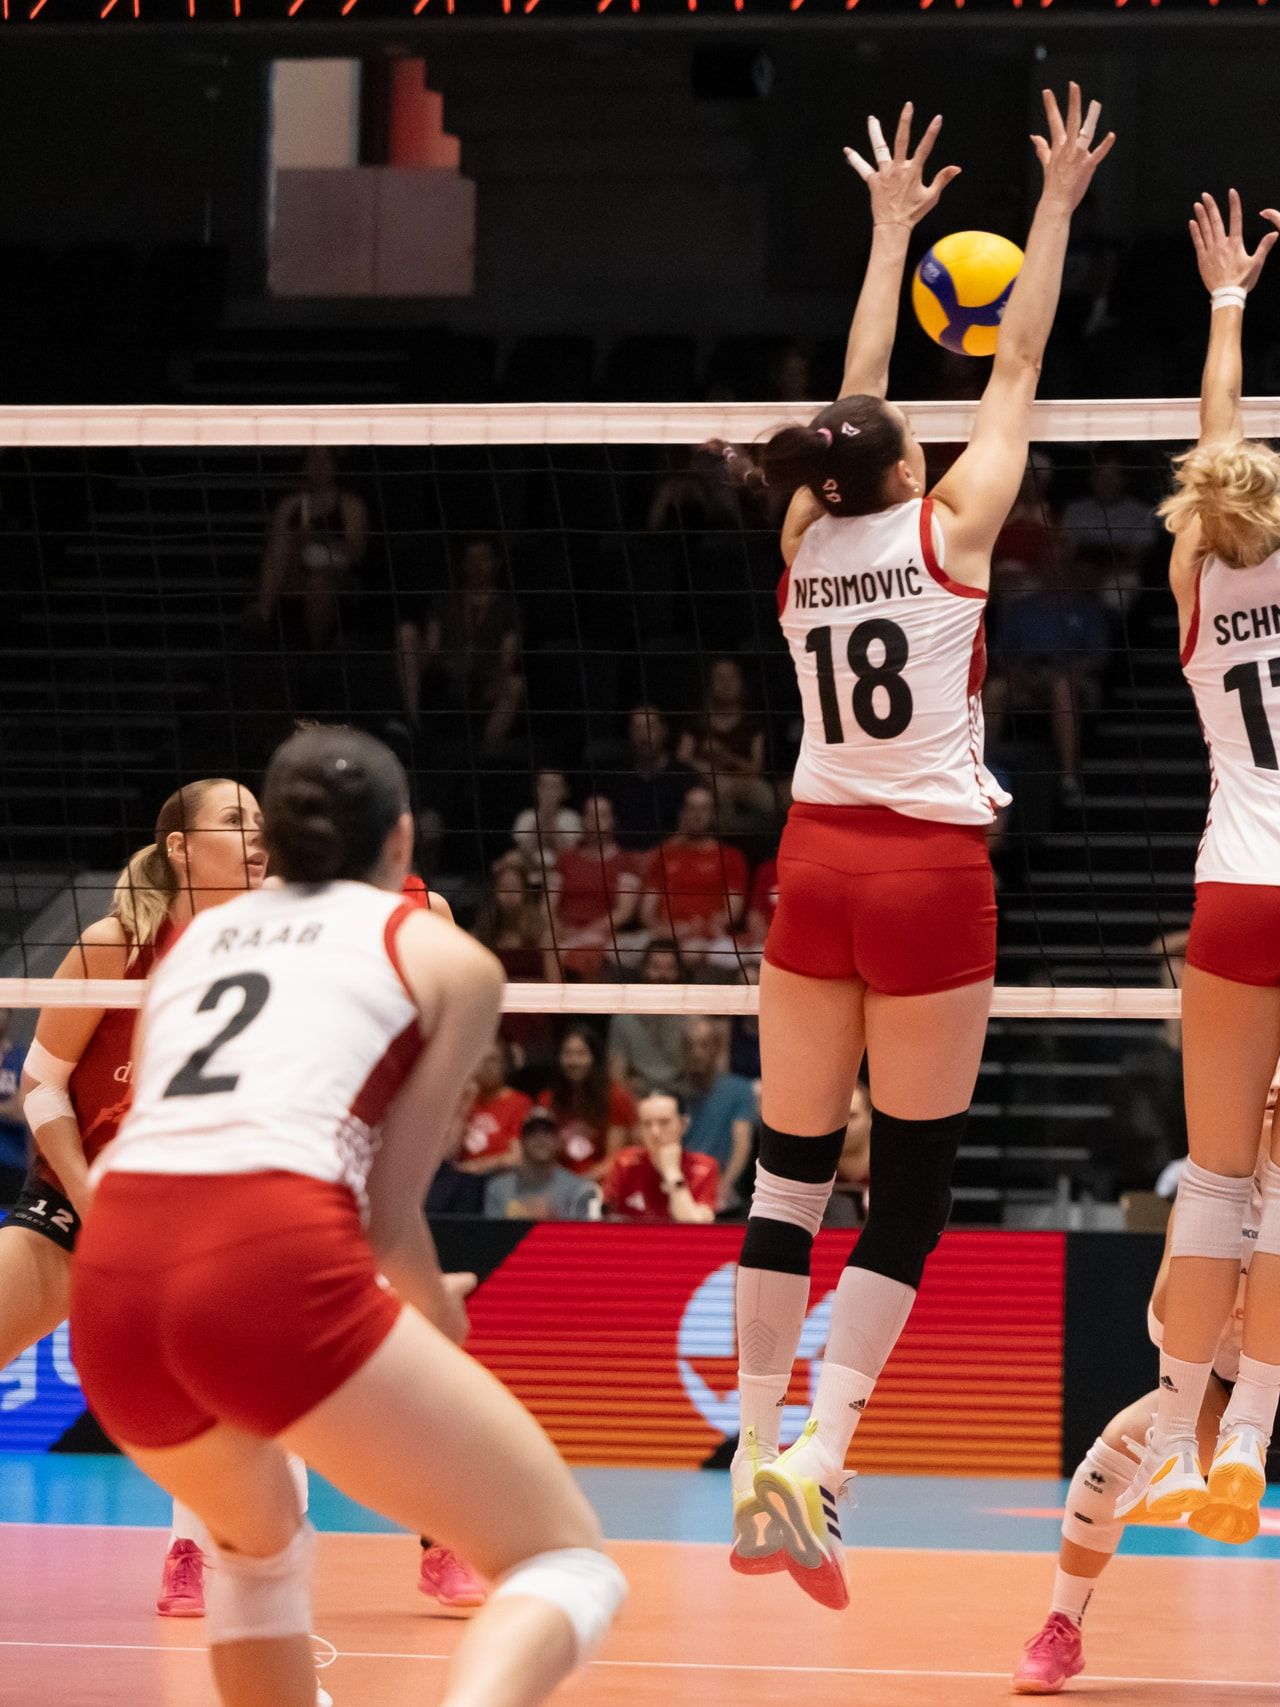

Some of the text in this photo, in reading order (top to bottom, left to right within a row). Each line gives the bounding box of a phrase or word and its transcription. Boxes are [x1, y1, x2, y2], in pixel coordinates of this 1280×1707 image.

[794, 559, 923, 609] NESIMOVIĆ
[806, 618, 913, 744] 18
[212, 921, 324, 953] RAAB
[163, 972, 270, 1098] 2
[28, 1199, 74, 1233] 12
